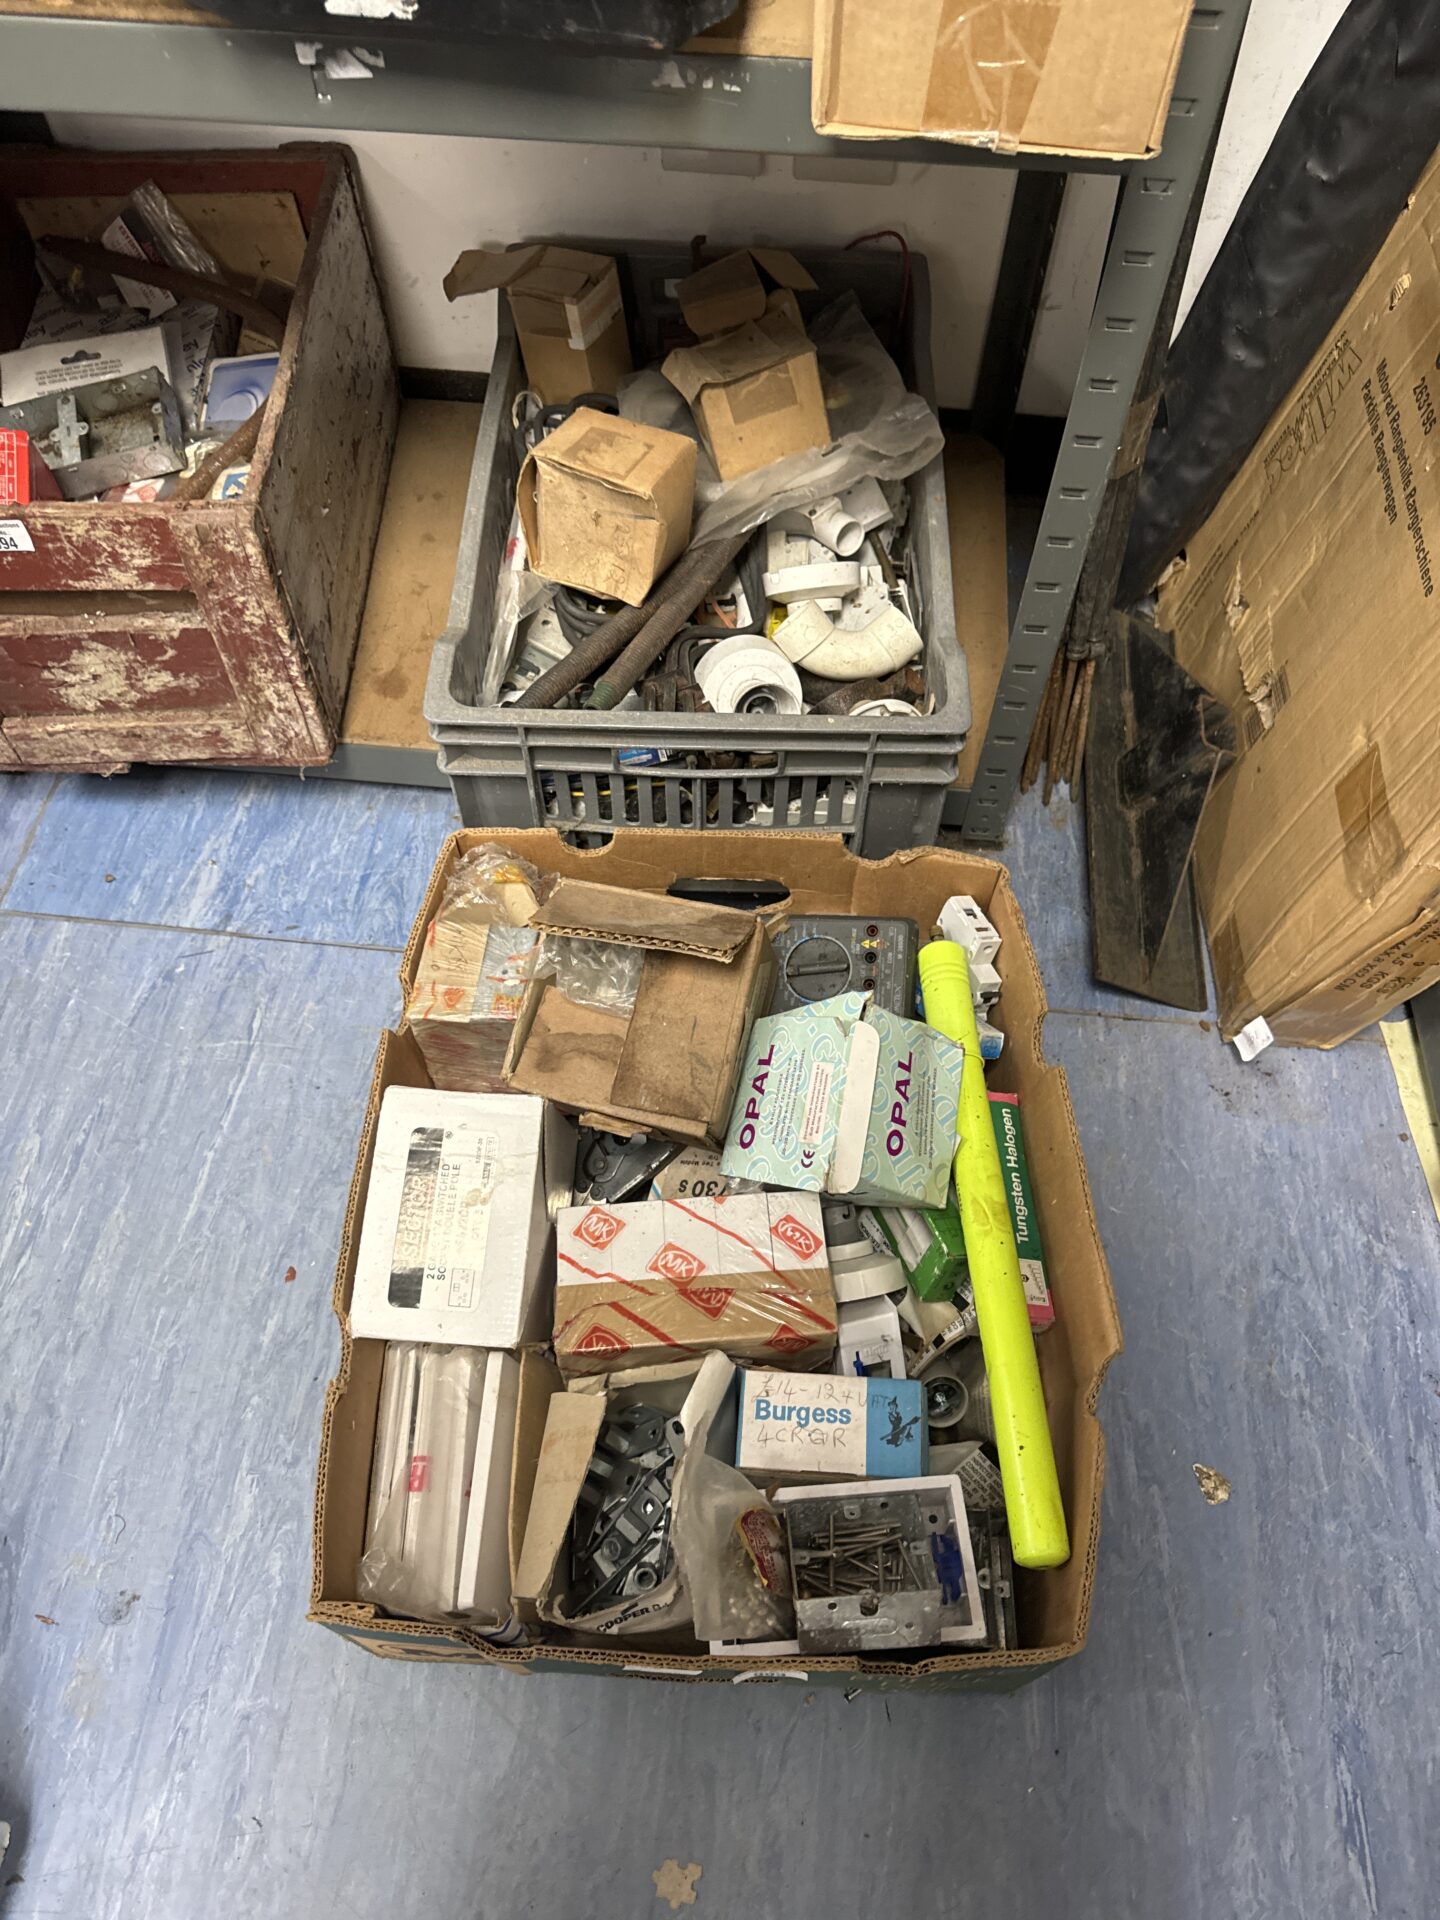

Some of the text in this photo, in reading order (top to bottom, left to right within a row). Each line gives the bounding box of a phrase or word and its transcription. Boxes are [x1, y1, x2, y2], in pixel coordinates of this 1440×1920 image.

[1411, 376, 1436, 435] 263195
[1373, 433, 1398, 526] Rangierwagen
[1375, 358, 1434, 598] Motorrad Rangierhilfe Rangierschiene
[740, 1043, 776, 1151] OPAL
[886, 1051, 914, 1157] OPAL
[1002, 1107, 1030, 1245] Tungsten Halogen
[584, 1215, 614, 1241] MK
[780, 1220, 814, 1253] MK
[661, 1252, 692, 1278] MK
[755, 1399, 852, 1427] Burgess
[597, 1606, 651, 1633] COOPER
